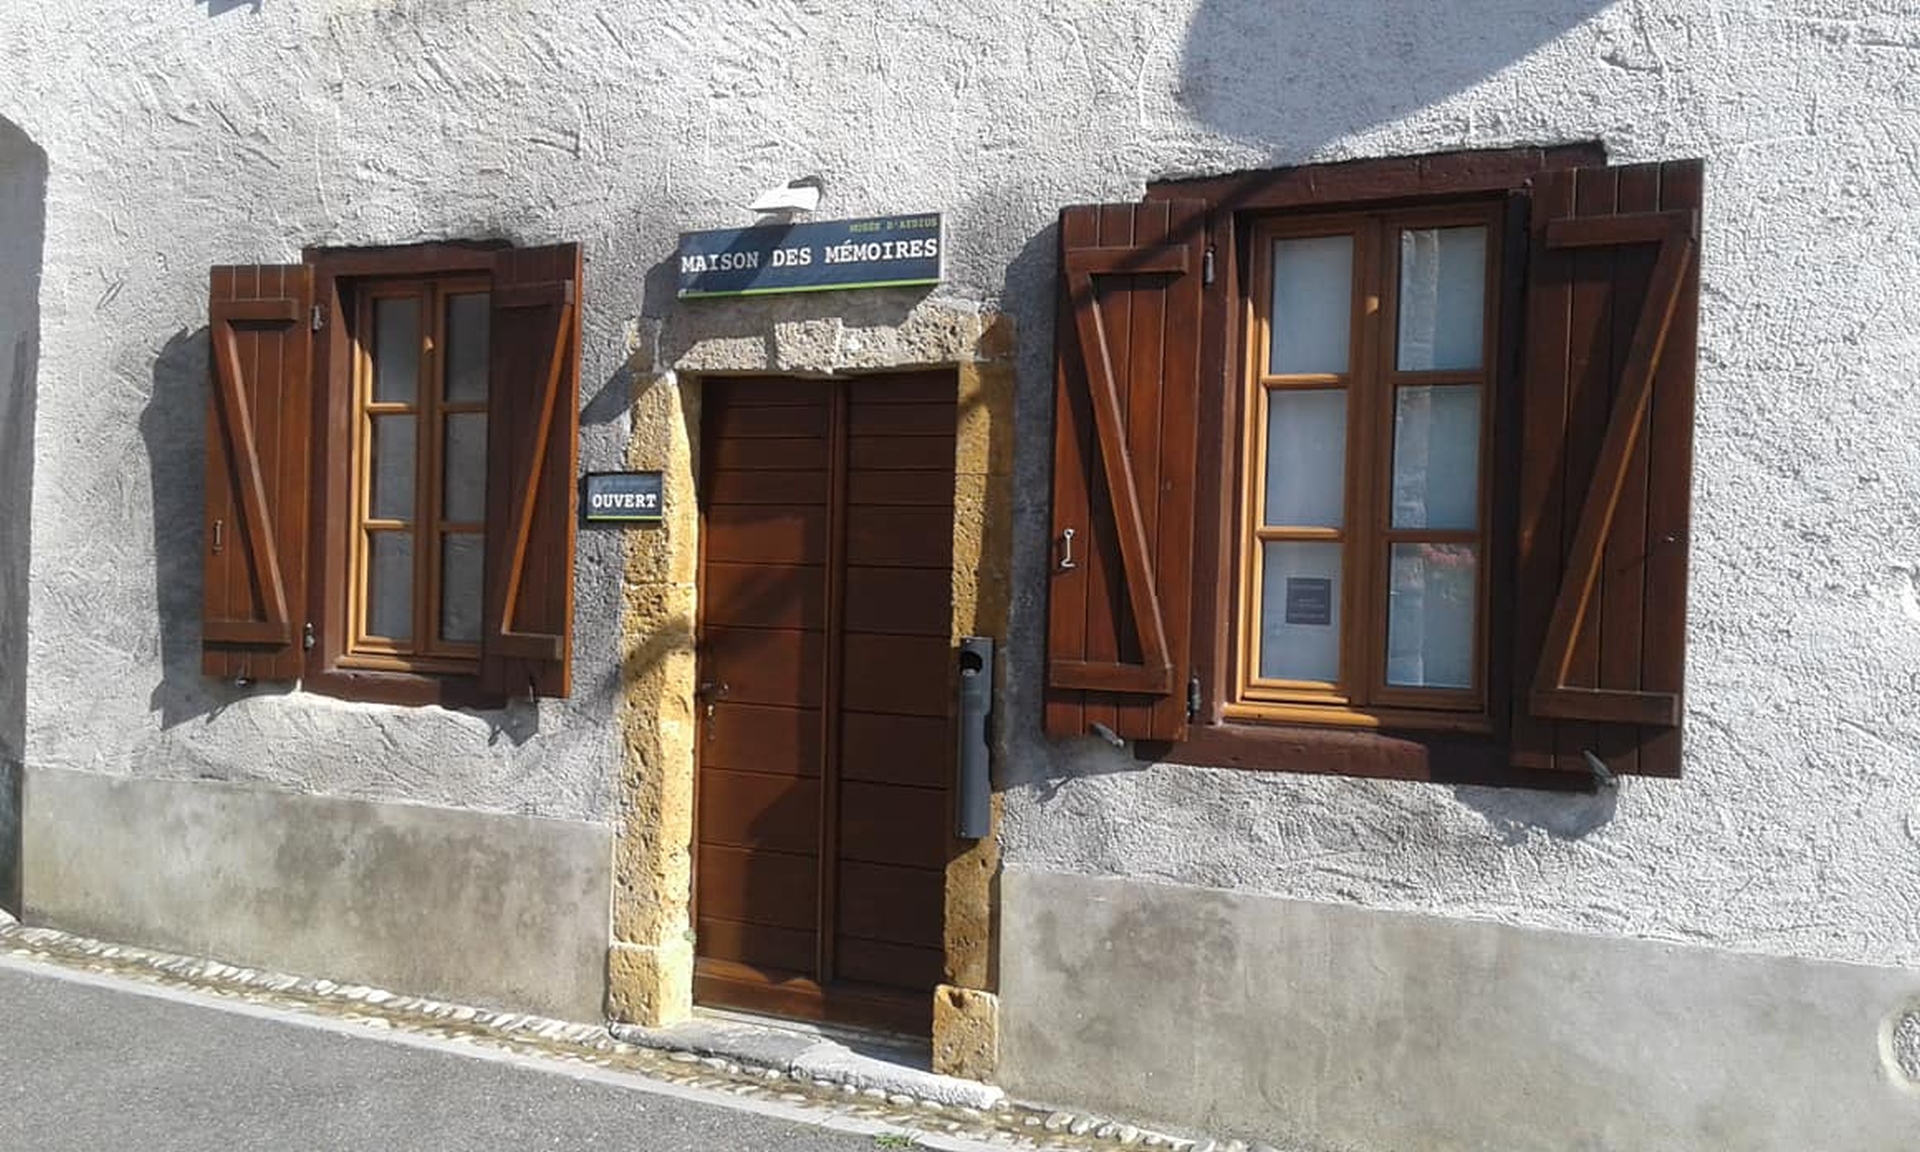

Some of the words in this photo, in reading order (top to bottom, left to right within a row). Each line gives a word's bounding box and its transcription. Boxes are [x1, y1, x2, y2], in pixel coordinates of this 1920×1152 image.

[681, 251, 759, 273] MAISON
[772, 247, 811, 267] DES
[824, 238, 938, 264] MÉMOIRES
[592, 493, 657, 508] OUVERT
